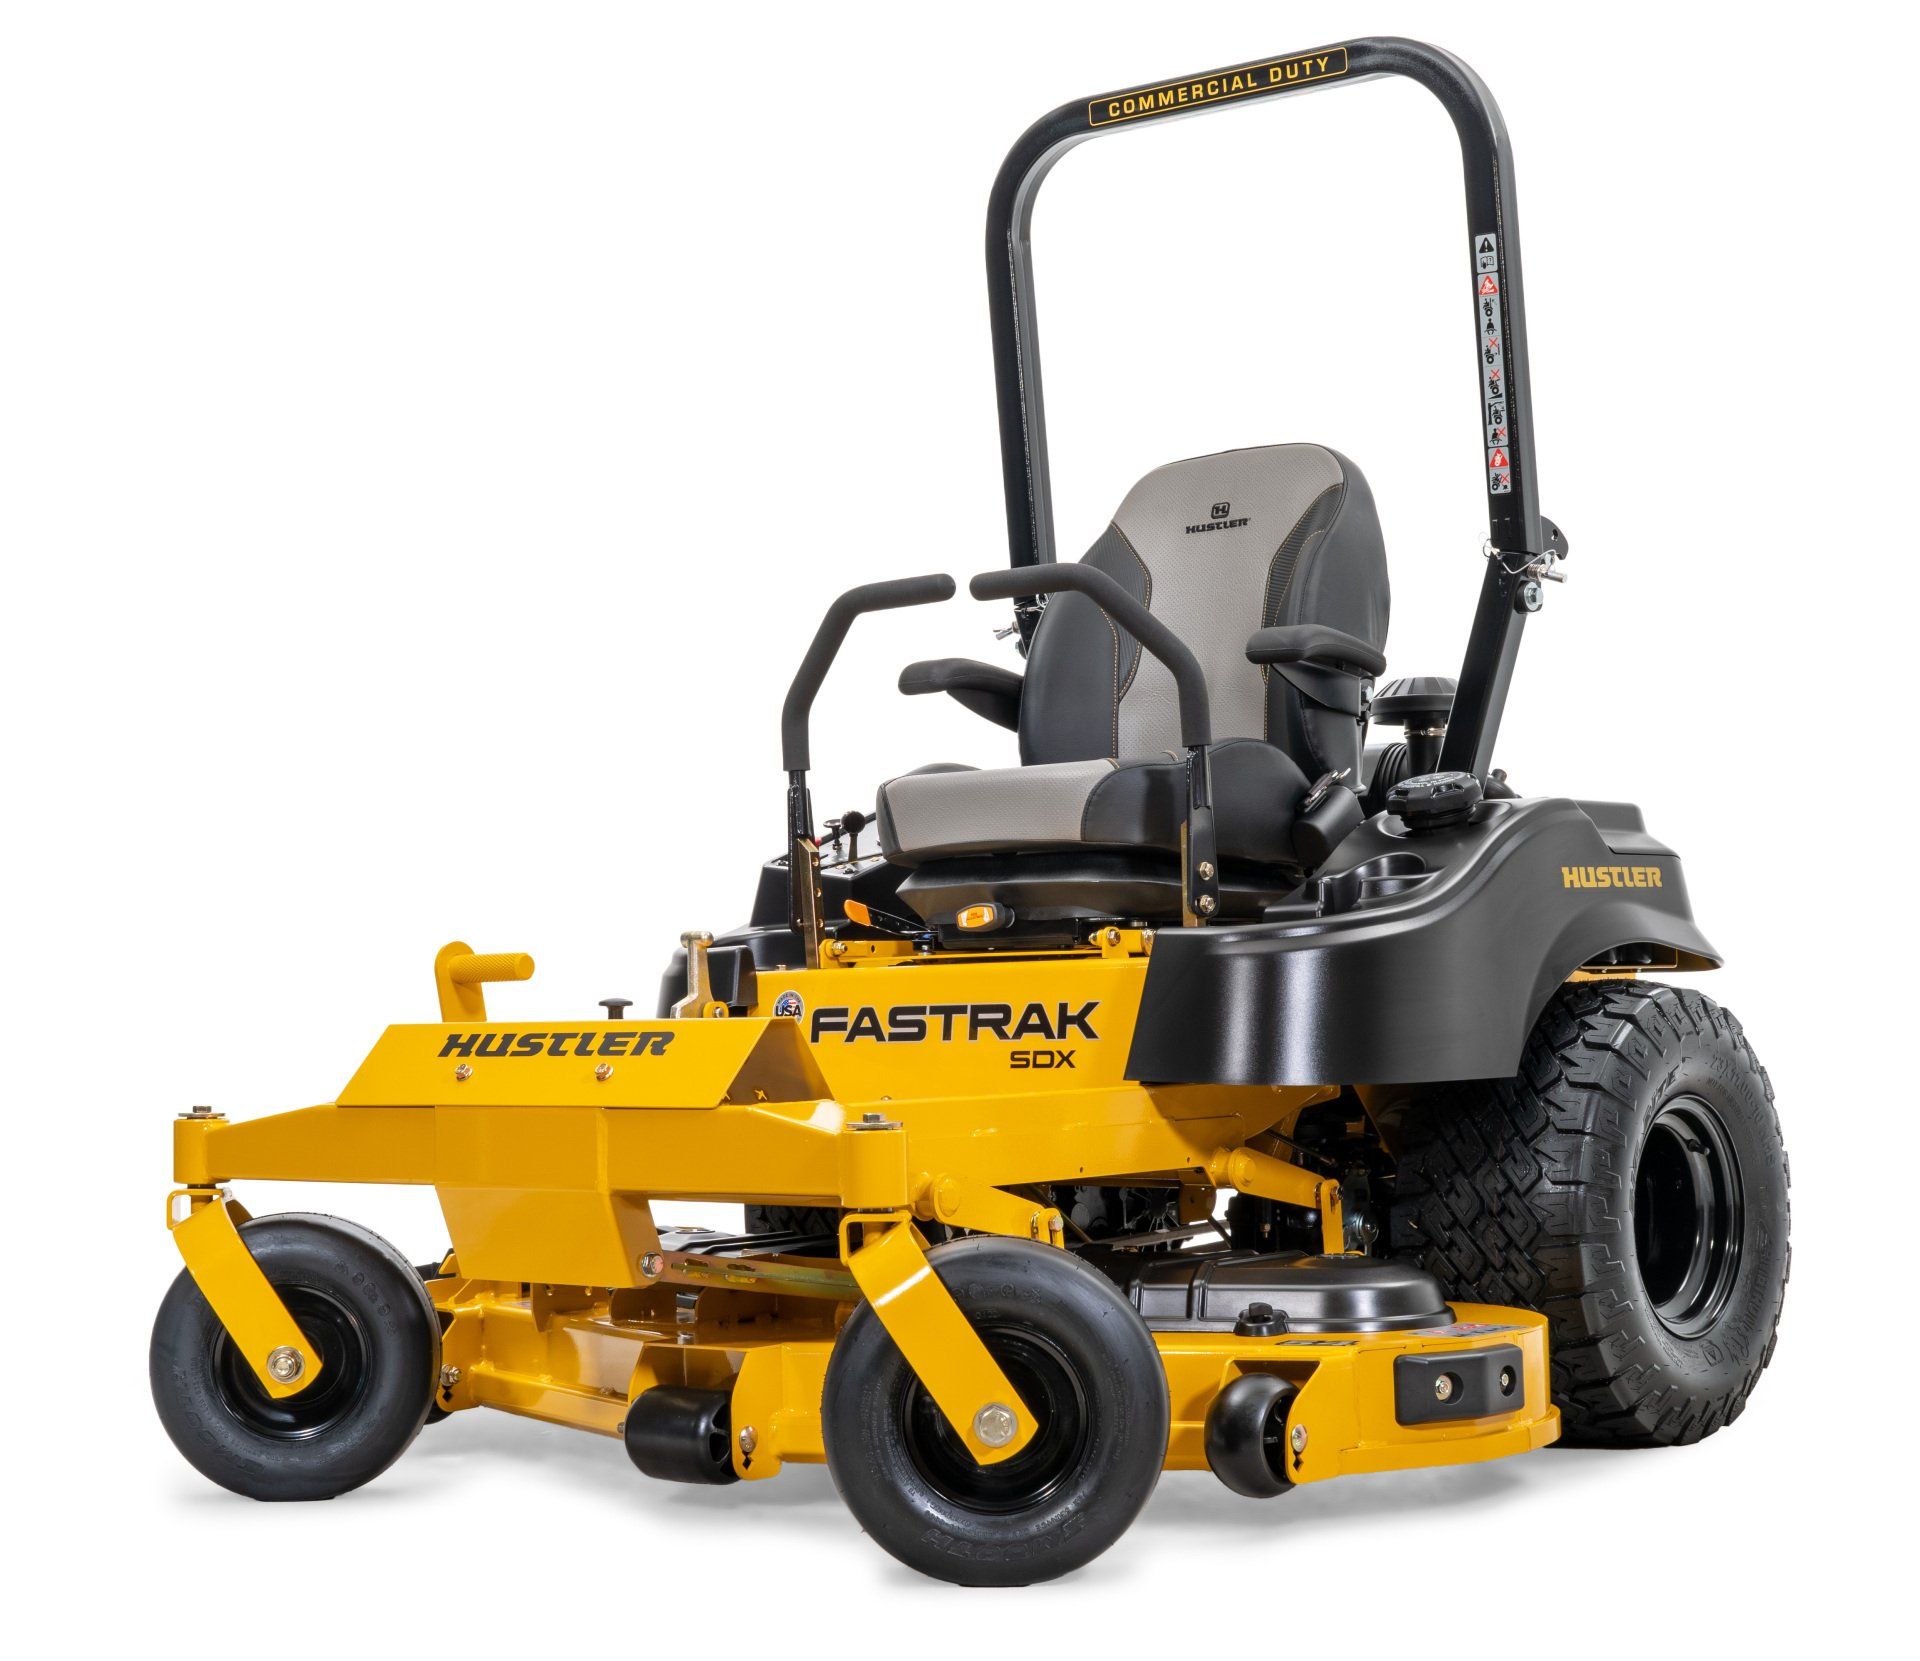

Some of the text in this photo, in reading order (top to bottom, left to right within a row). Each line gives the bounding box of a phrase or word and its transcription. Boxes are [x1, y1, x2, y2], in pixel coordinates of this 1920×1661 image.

[1108, 56, 1329, 118] COMMERCIAL DUTY
[1185, 518, 1249, 534] HUSTLER
[1561, 866, 1663, 888] HUSTLER
[776, 1005, 801, 1016] USA
[811, 1001, 1100, 1043] FASTRAK
[437, 1031, 675, 1057] HUSTLER
[1010, 1050, 1077, 1069] SDX
